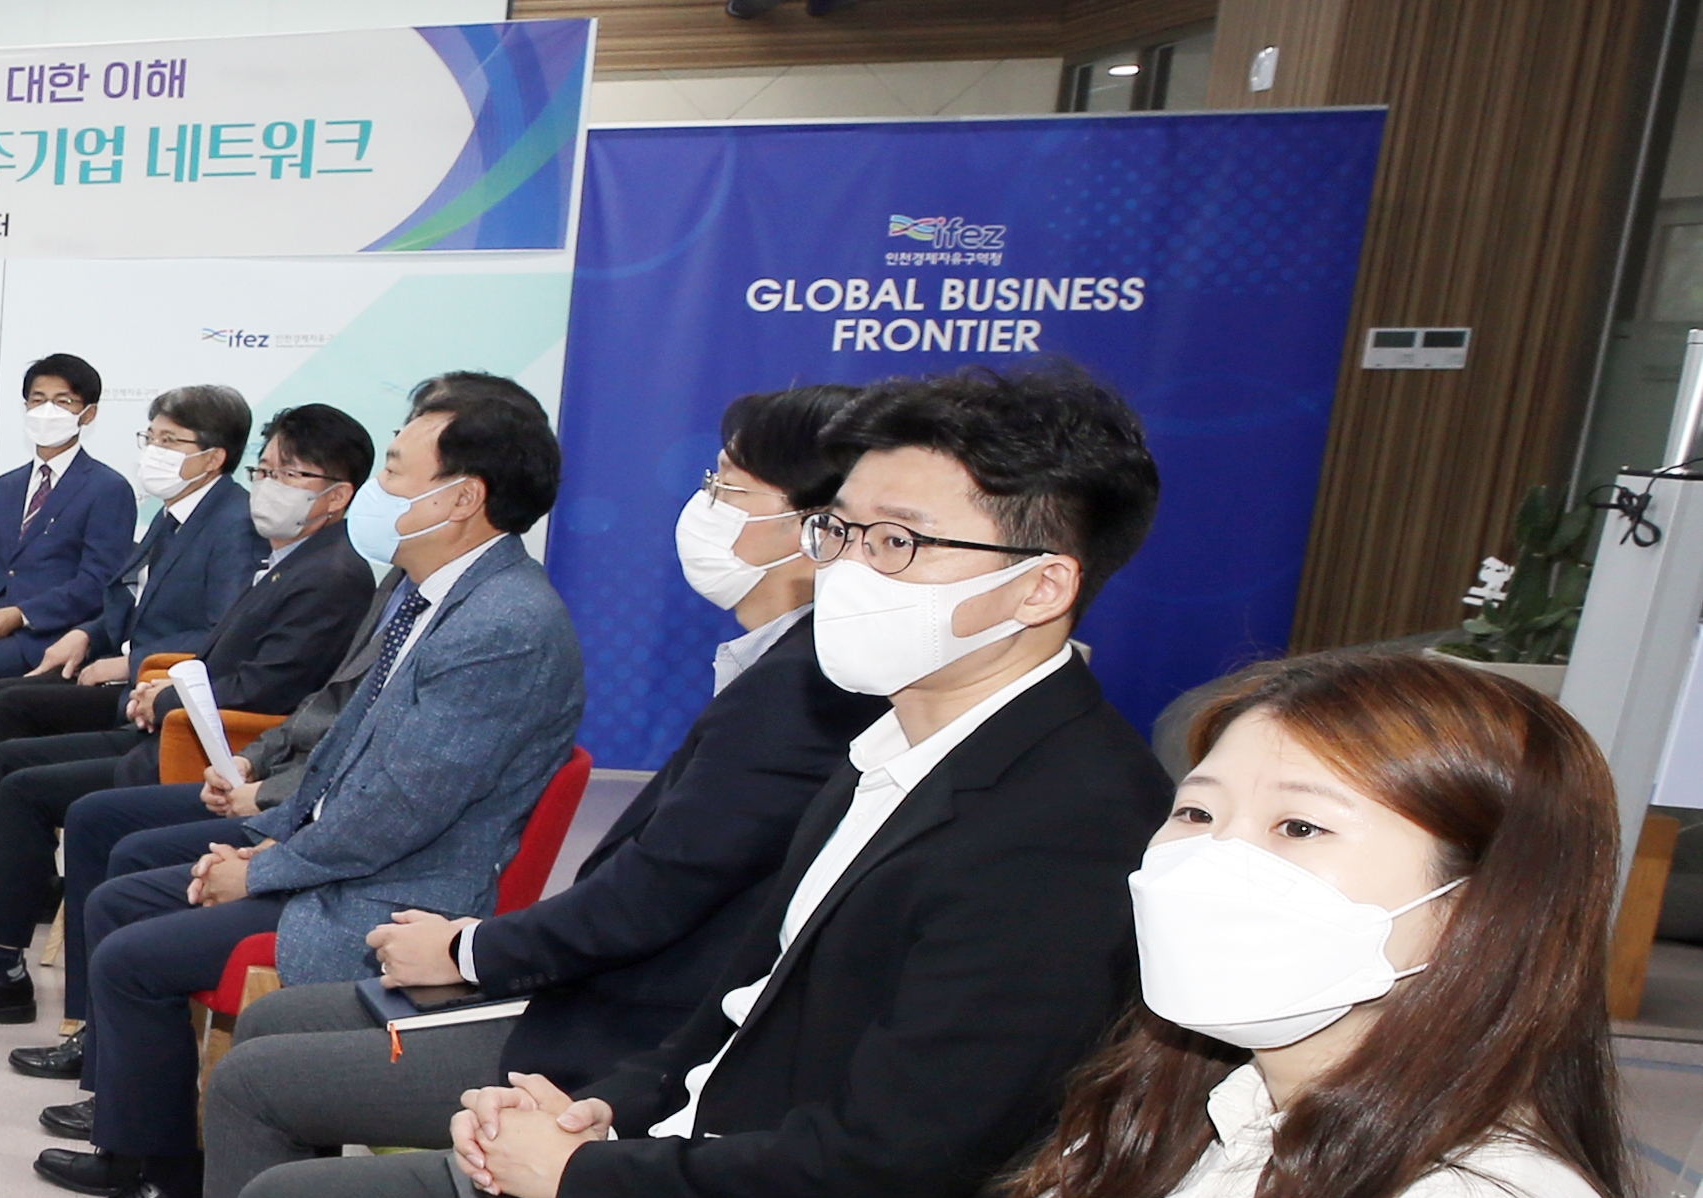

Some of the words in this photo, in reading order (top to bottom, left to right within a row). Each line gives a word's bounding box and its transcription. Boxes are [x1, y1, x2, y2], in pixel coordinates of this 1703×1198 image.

[6, 61, 90, 104] 대한
[102, 57, 187, 101] 이해
[145, 118, 375, 184] 네트워크
[933, 216, 1007, 250] ifez
[885, 251, 1003, 267] 인천경제자유구역청
[745, 278, 925, 312] GLOBAL
[939, 277, 1146, 312] BUSINESS
[228, 329, 270, 348] ifez
[831, 318, 1043, 353] FRONTIER
